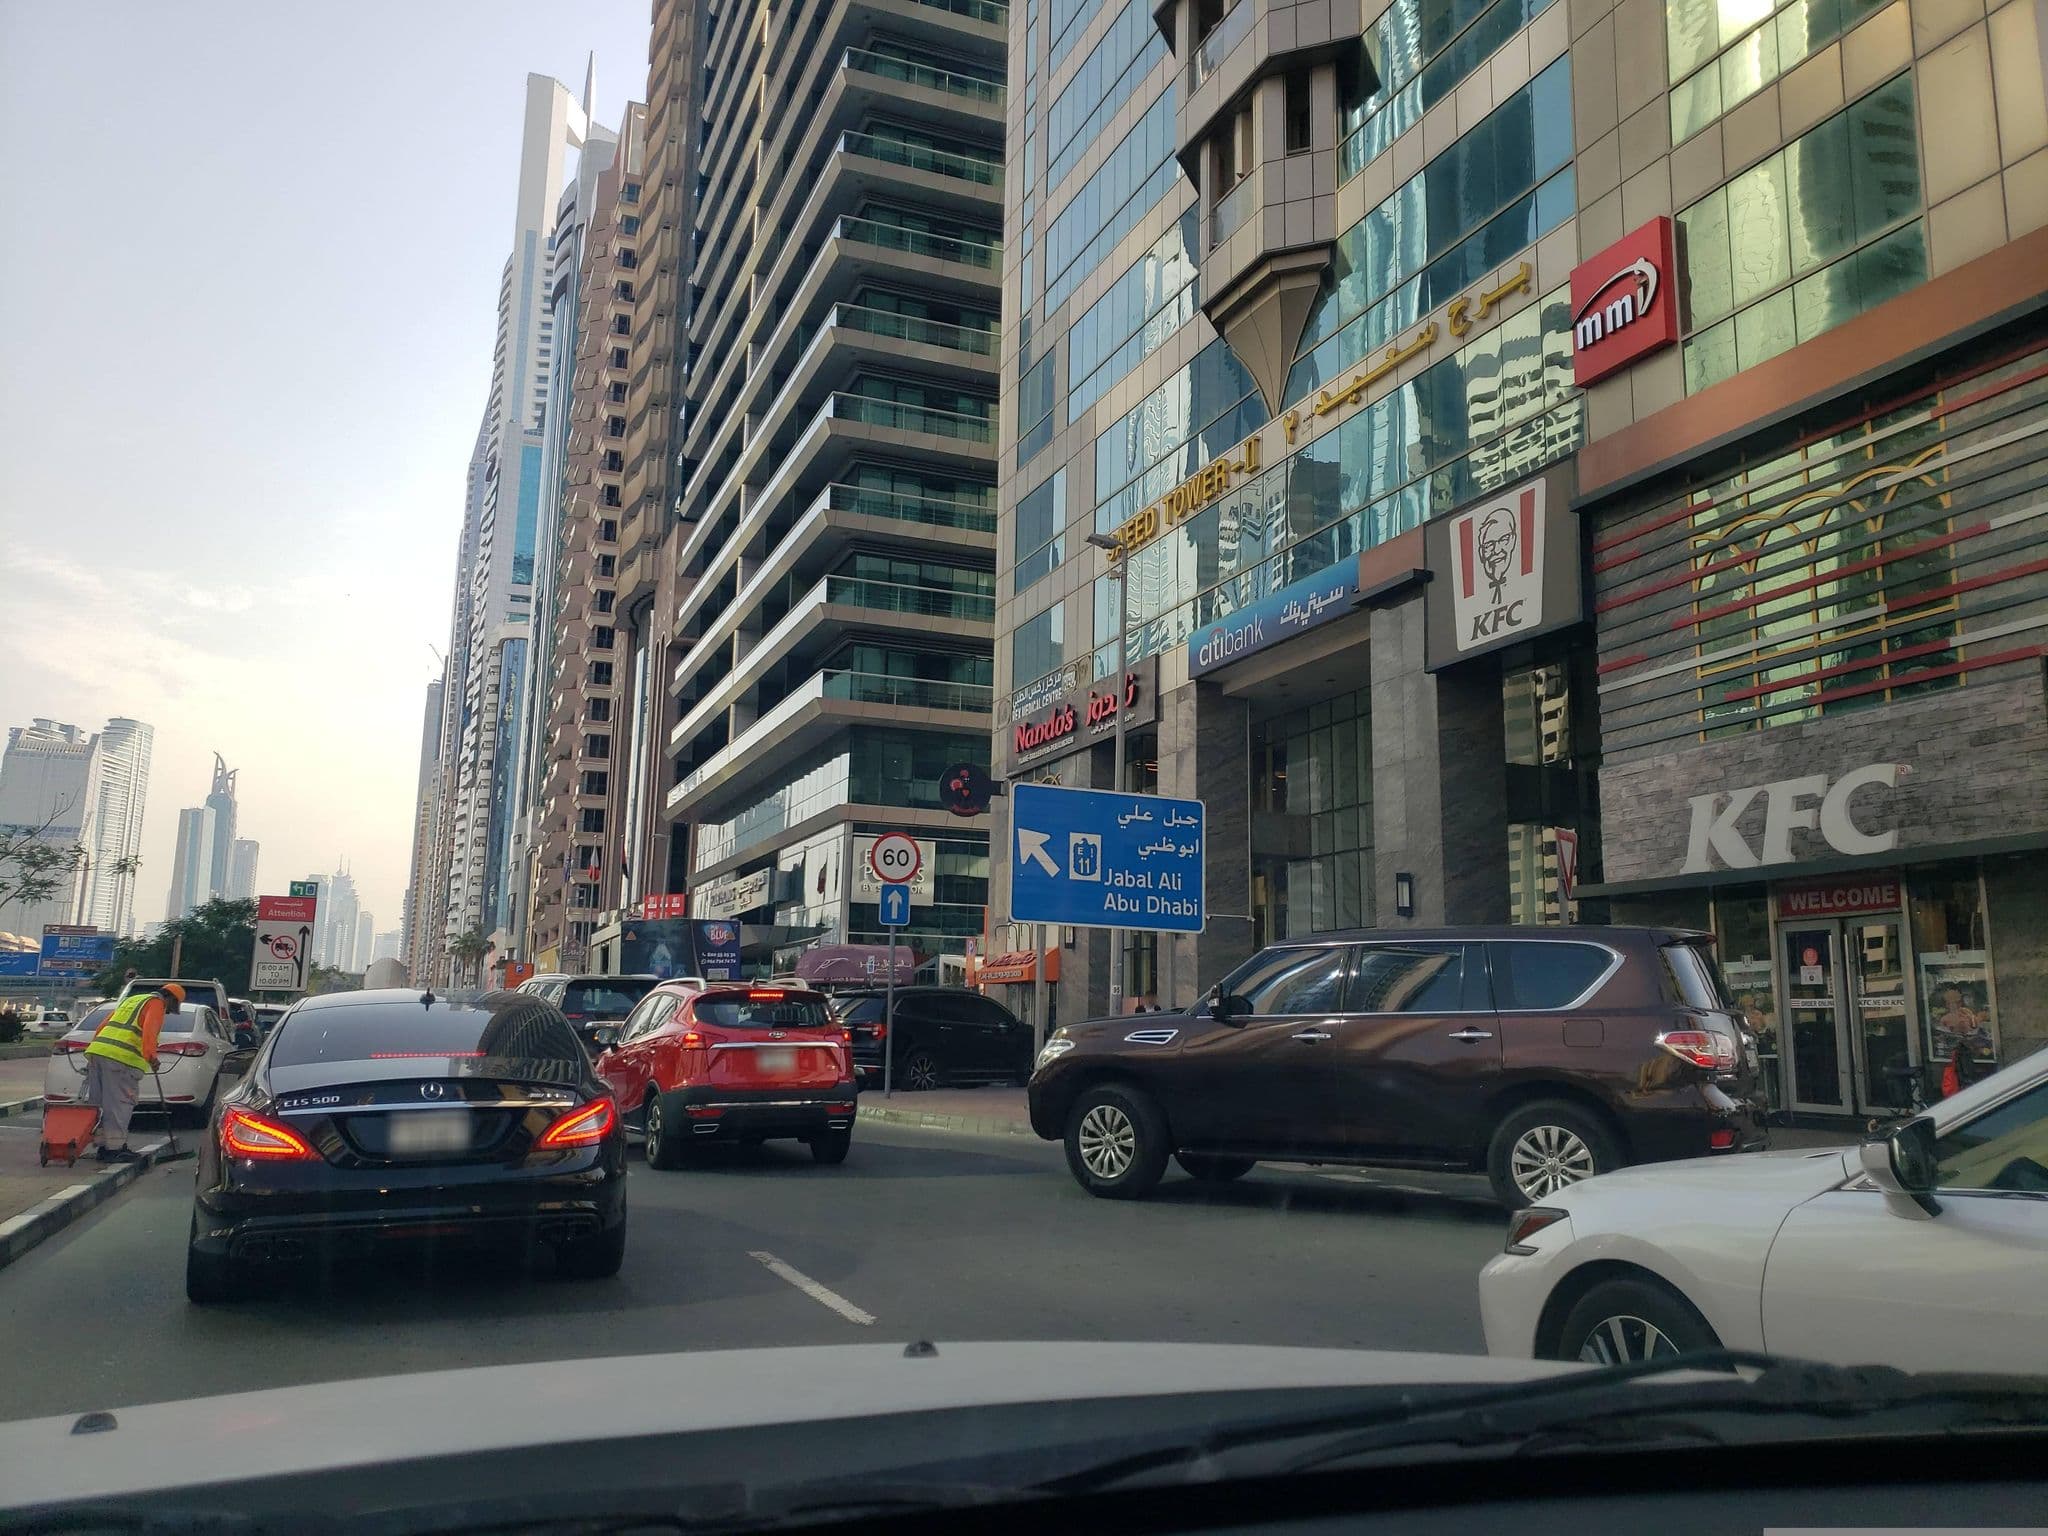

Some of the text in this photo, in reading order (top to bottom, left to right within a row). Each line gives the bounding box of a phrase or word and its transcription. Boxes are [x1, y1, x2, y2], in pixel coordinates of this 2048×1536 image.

[1448, 261, 1532, 337] برج
[1572, 257, 1658, 350] mmi
[1314, 321, 1439, 416] سعيد
[1470, 599, 1528, 641] KFC
[1199, 613, 1265, 667] citibank
[1022, 697, 1041, 718] MEDICAL
[1042, 687, 1062, 708] CENTRE
[1014, 704, 1075, 753] Nando's
[1117, 805, 1199, 829] جبل علي
[1680, 763, 1899, 875] KFC
[883, 849, 909, 867] 60
[1078, 847, 1084, 855] E
[1078, 858, 1090, 874] 11
[1104, 868, 1182, 891] Jabal Ali
[1104, 893, 1198, 916] Abu Dhabi
[1790, 885, 1895, 911] WELCOME
[268, 909, 306, 918] Attention
[284, 1095, 340, 1108] CLS 500
